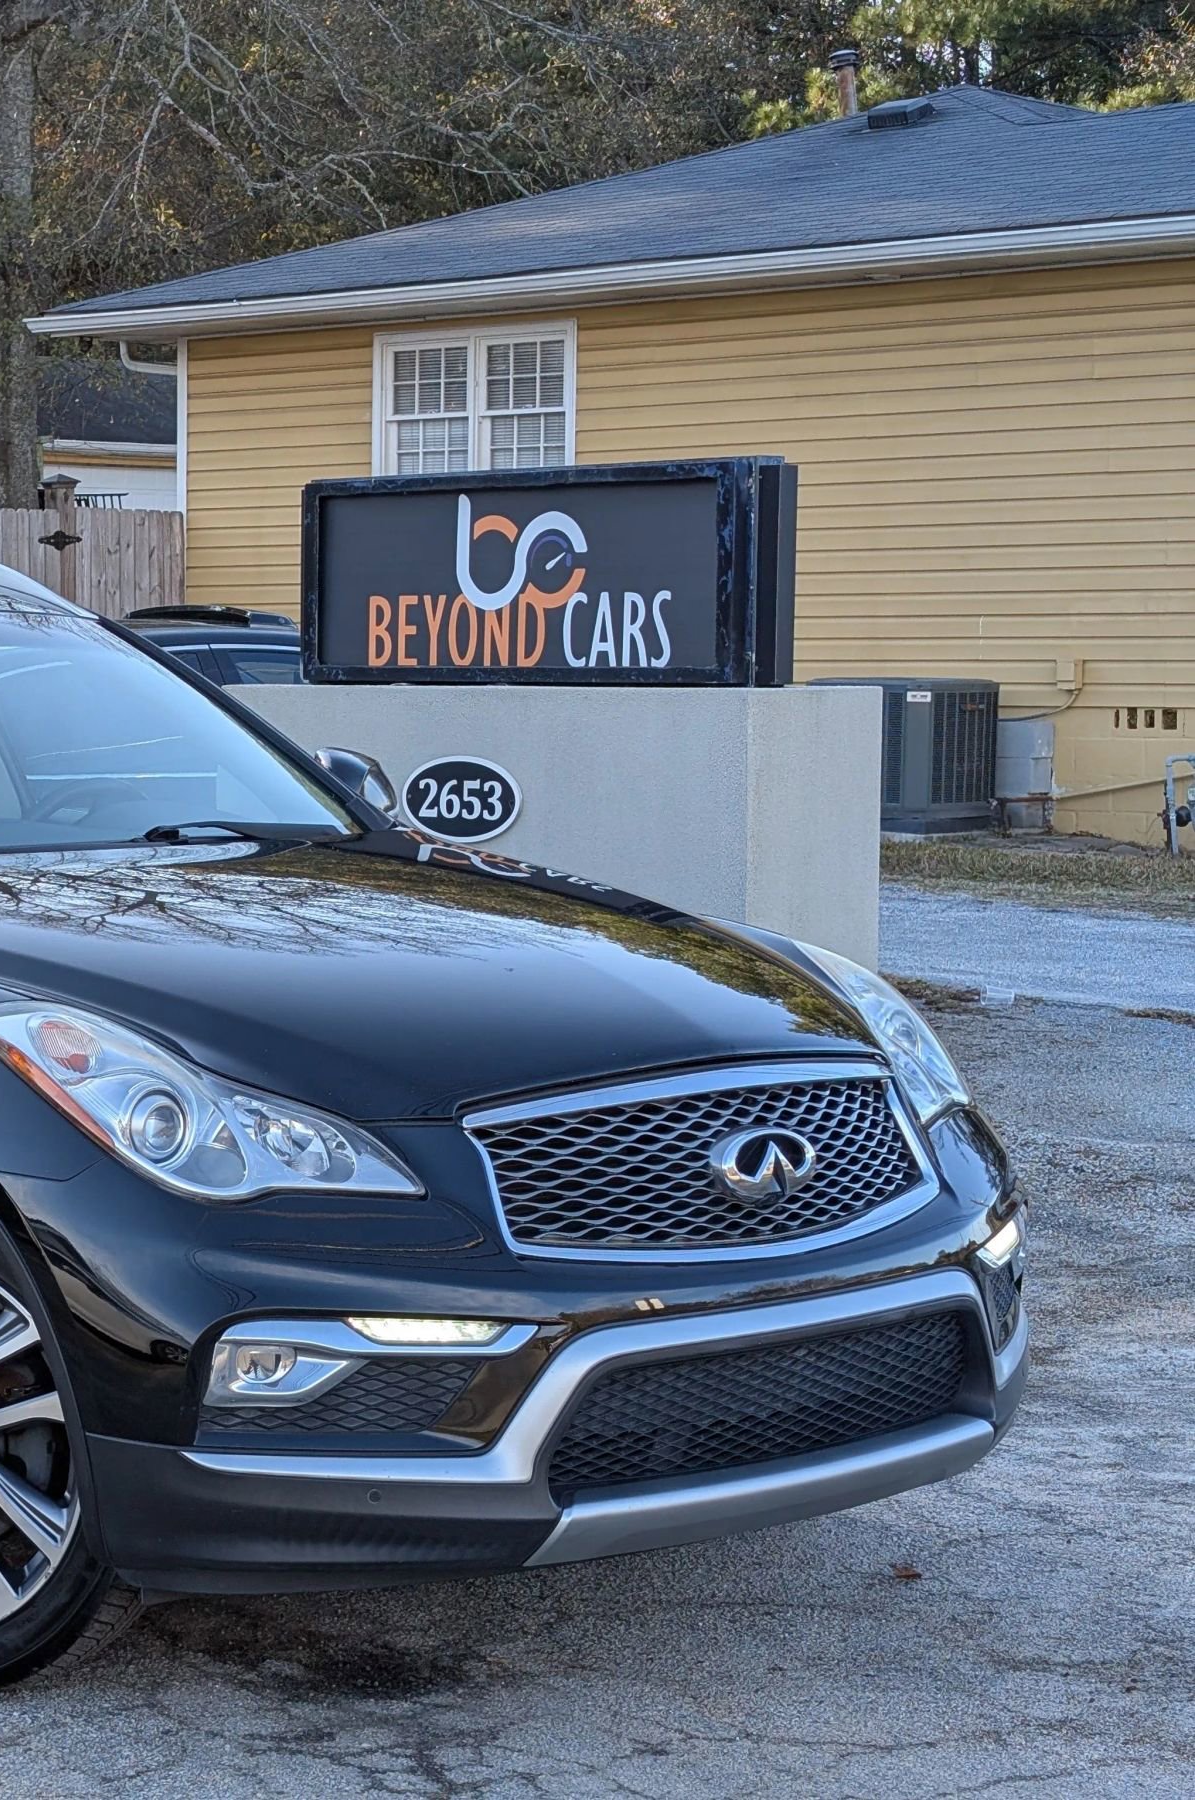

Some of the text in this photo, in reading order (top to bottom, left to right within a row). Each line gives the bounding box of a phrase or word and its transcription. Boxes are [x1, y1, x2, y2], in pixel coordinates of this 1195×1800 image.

[368, 590, 672, 668] BEYOND CARS
[417, 778, 503, 820] 2653
